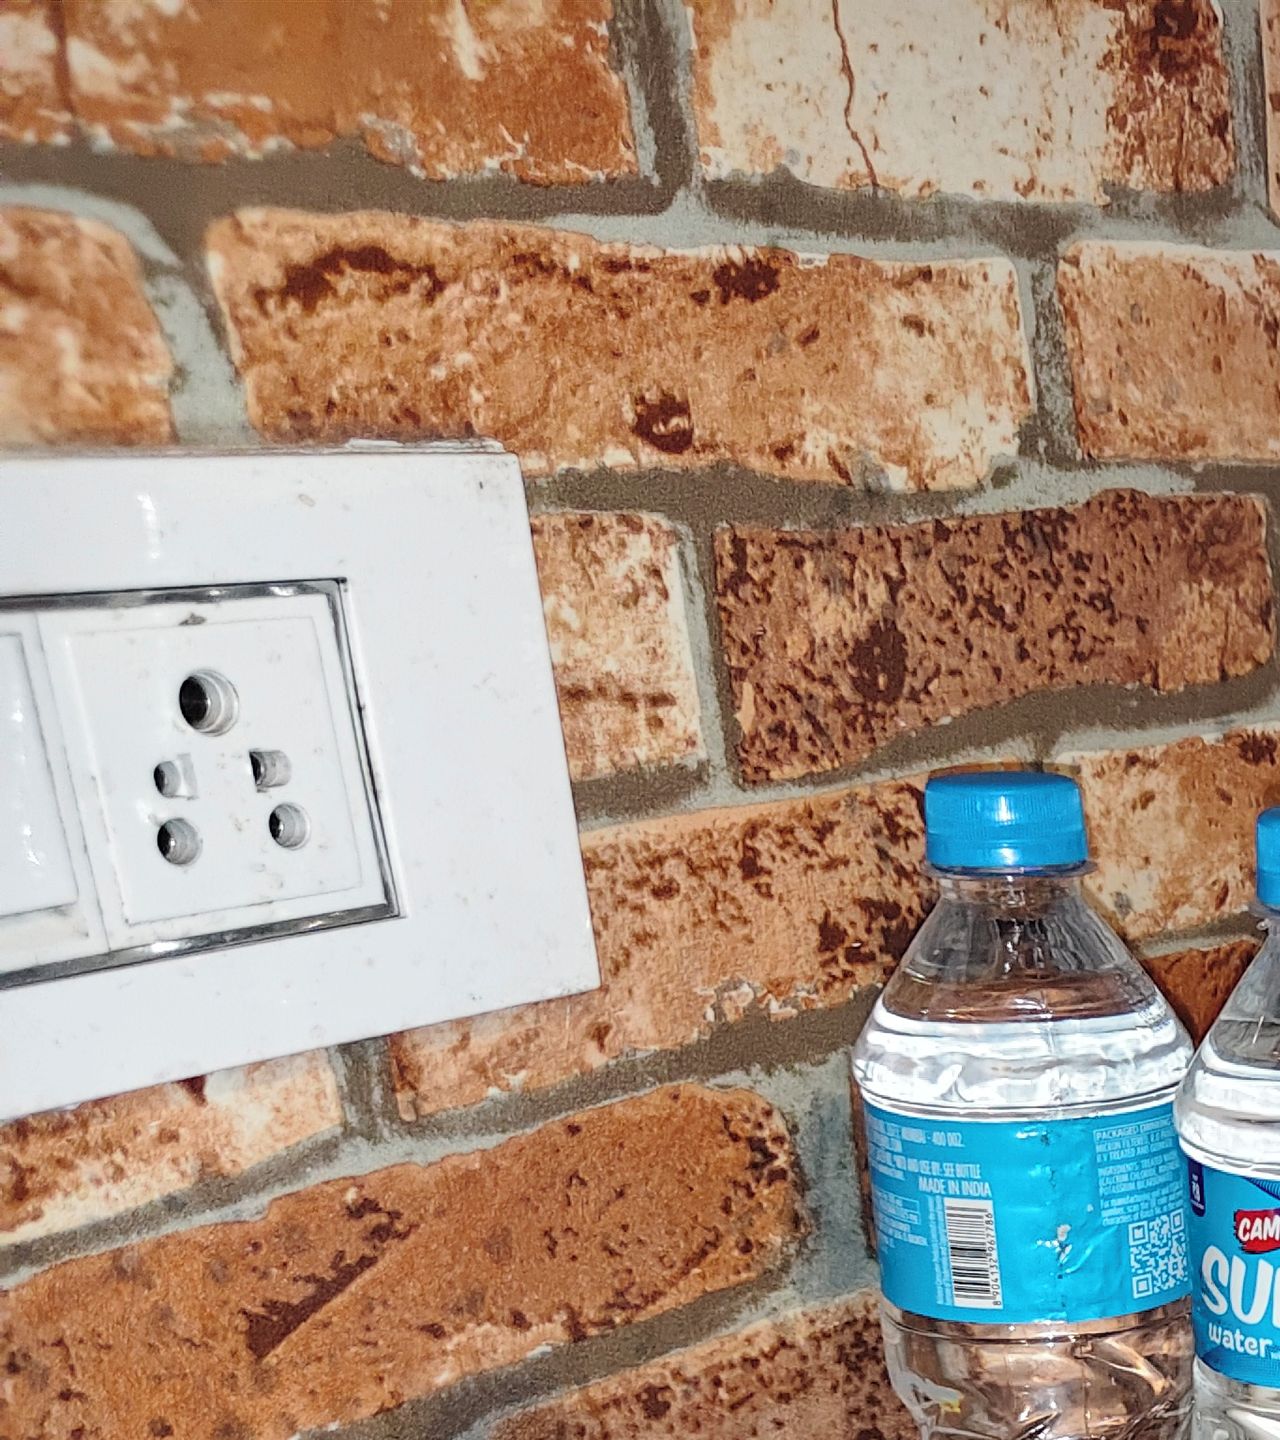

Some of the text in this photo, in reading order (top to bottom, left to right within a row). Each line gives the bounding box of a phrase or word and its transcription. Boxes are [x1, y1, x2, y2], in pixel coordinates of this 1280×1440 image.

[918, 1176, 992, 1197] MADE IN INDIA
[1208, 1321, 1273, 1359] water
